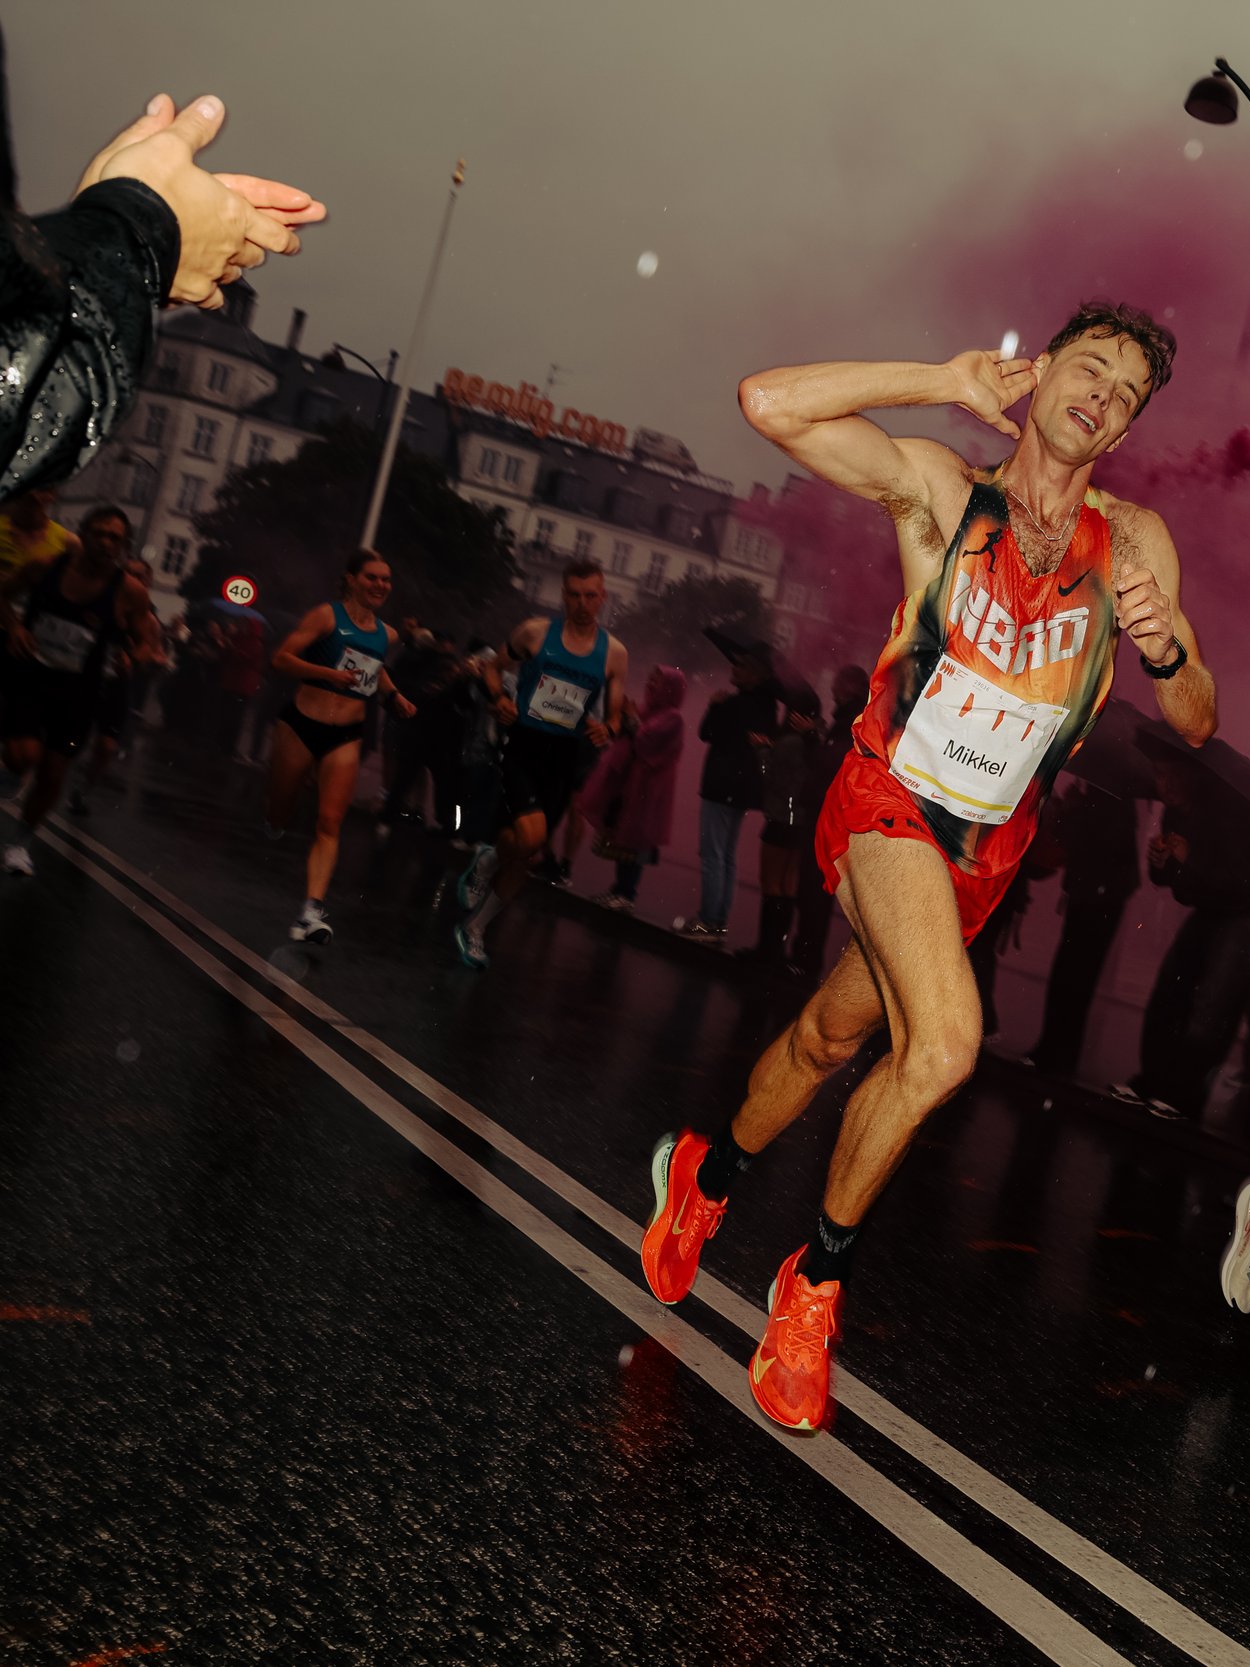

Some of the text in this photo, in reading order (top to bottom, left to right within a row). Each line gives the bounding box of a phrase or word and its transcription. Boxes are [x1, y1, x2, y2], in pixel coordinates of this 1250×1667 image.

[443, 368, 628, 453] nemlig.com
[229, 585, 251, 599] 40
[947, 569, 1090, 676] NBRO
[942, 739, 1008, 778] Mikkel
